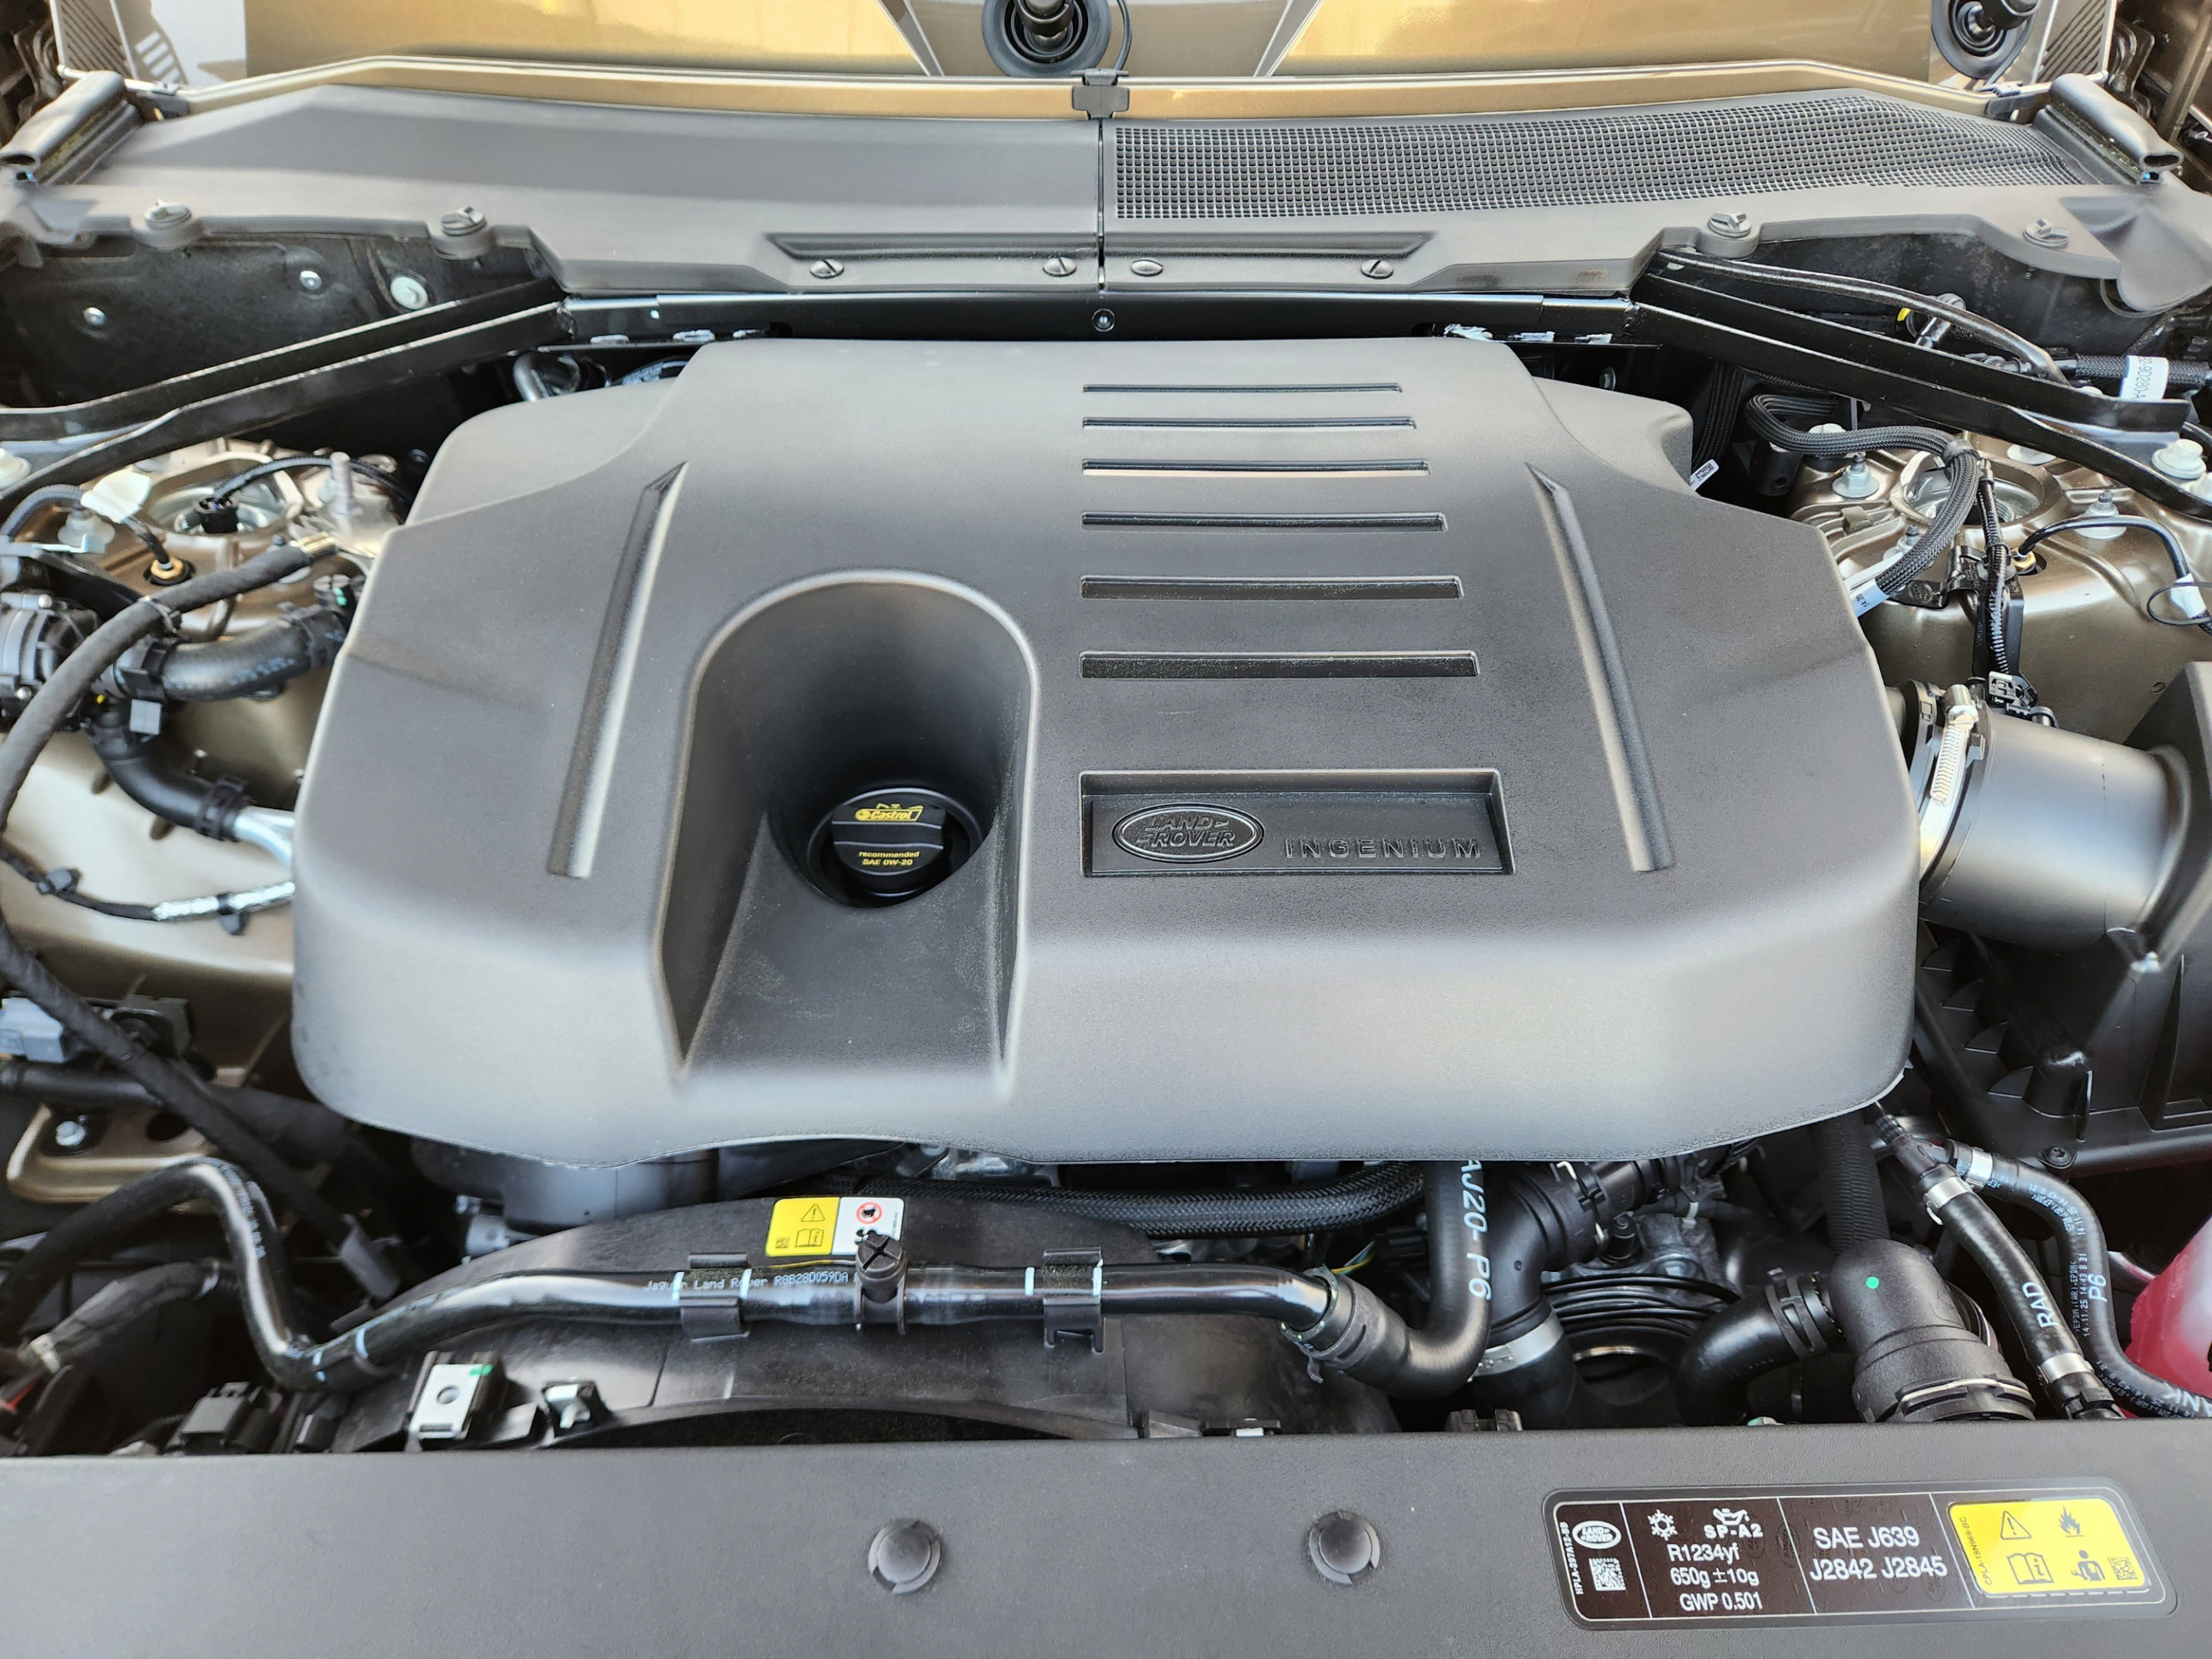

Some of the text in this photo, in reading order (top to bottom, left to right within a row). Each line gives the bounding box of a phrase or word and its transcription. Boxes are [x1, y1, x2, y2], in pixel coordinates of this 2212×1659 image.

[869, 810, 912, 820] Castrol
[1145, 815, 1217, 830] LAND
[1152, 830, 1236, 847] ROVER
[1284, 837, 1482, 859] INGENIUM
[862, 858, 913, 866] SAE 0W-20
[694, 1279, 725, 1290] Land
[1466, 1253, 1492, 1301] P6
[2088, 1273, 2108, 1302] P6
[2022, 1281, 2061, 1327] RAD
[1581, 1526, 1605, 1535] LAND
[1584, 1535, 1614, 1543] ROVER
[1704, 1523, 1764, 1538] SP-A2
[1813, 1526, 1864, 1549] SAE
[1868, 1525, 1920, 1548] J639
[1666, 1542, 1740, 1565] R1234yf
[1670, 1566, 1760, 1588] 650g ±10g
[1810, 1555, 1949, 1581] J2842 J2845
[1680, 1591, 1763, 1611] GWP 0.501
